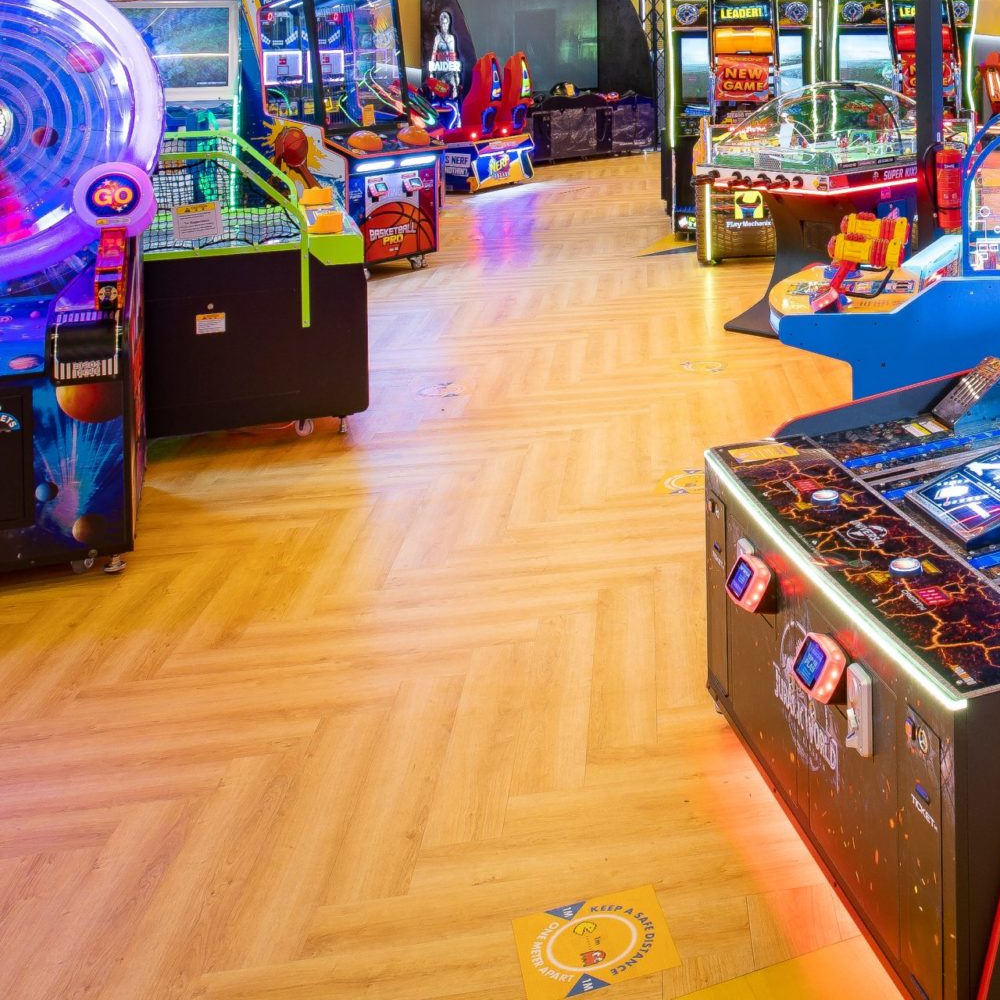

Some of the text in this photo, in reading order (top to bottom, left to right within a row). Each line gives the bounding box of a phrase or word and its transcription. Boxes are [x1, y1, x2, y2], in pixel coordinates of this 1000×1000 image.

[428, 61, 461, 71] RAIDER
[725, 67, 763, 80] NEW
[723, 81, 764, 92] GAME
[451, 156, 469, 165] NERF
[883, 168, 903, 181] SUPER
[94, 186, 134, 206] GO
[369, 221, 417, 242] BASKETBALL
[383, 234, 404, 245] PRO
[590, 904, 623, 913] KEEP
[634, 912, 654, 931] SAFE
[530, 921, 576, 982] ONE METER APART
[610, 933, 655, 975] DISTANCE
[582, 978, 594, 992] 1M
